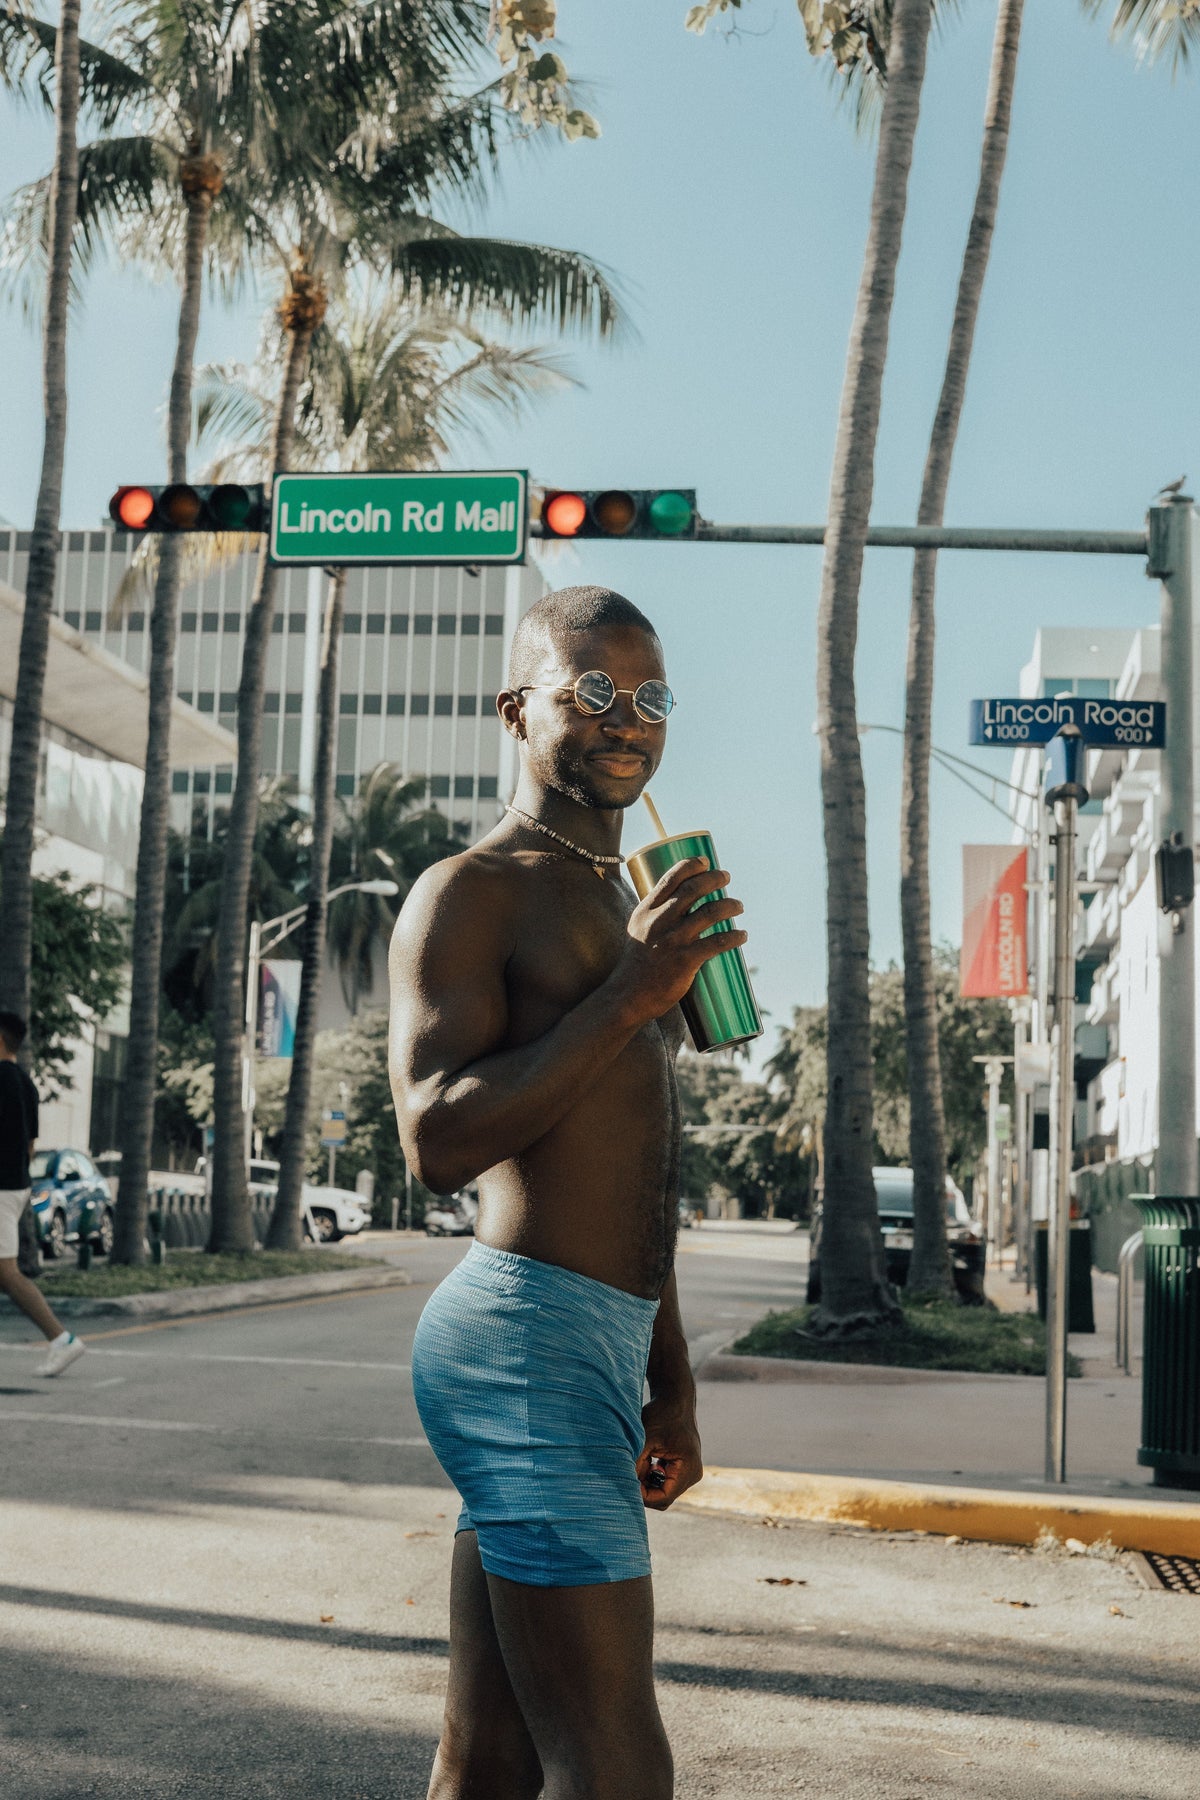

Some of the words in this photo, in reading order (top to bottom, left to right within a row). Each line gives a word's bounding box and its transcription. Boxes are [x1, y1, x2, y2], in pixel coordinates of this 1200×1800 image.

[280, 502, 391, 533] Lincoln
[402, 501, 444, 532] Rd
[455, 501, 516, 532] Mall
[984, 701, 1074, 724] Lincoln
[1084, 702, 1154, 728] Road
[997, 725, 1030, 739] 1000
[1115, 727, 1143, 742] 900
[999, 918, 1014, 991] LINCOLN
